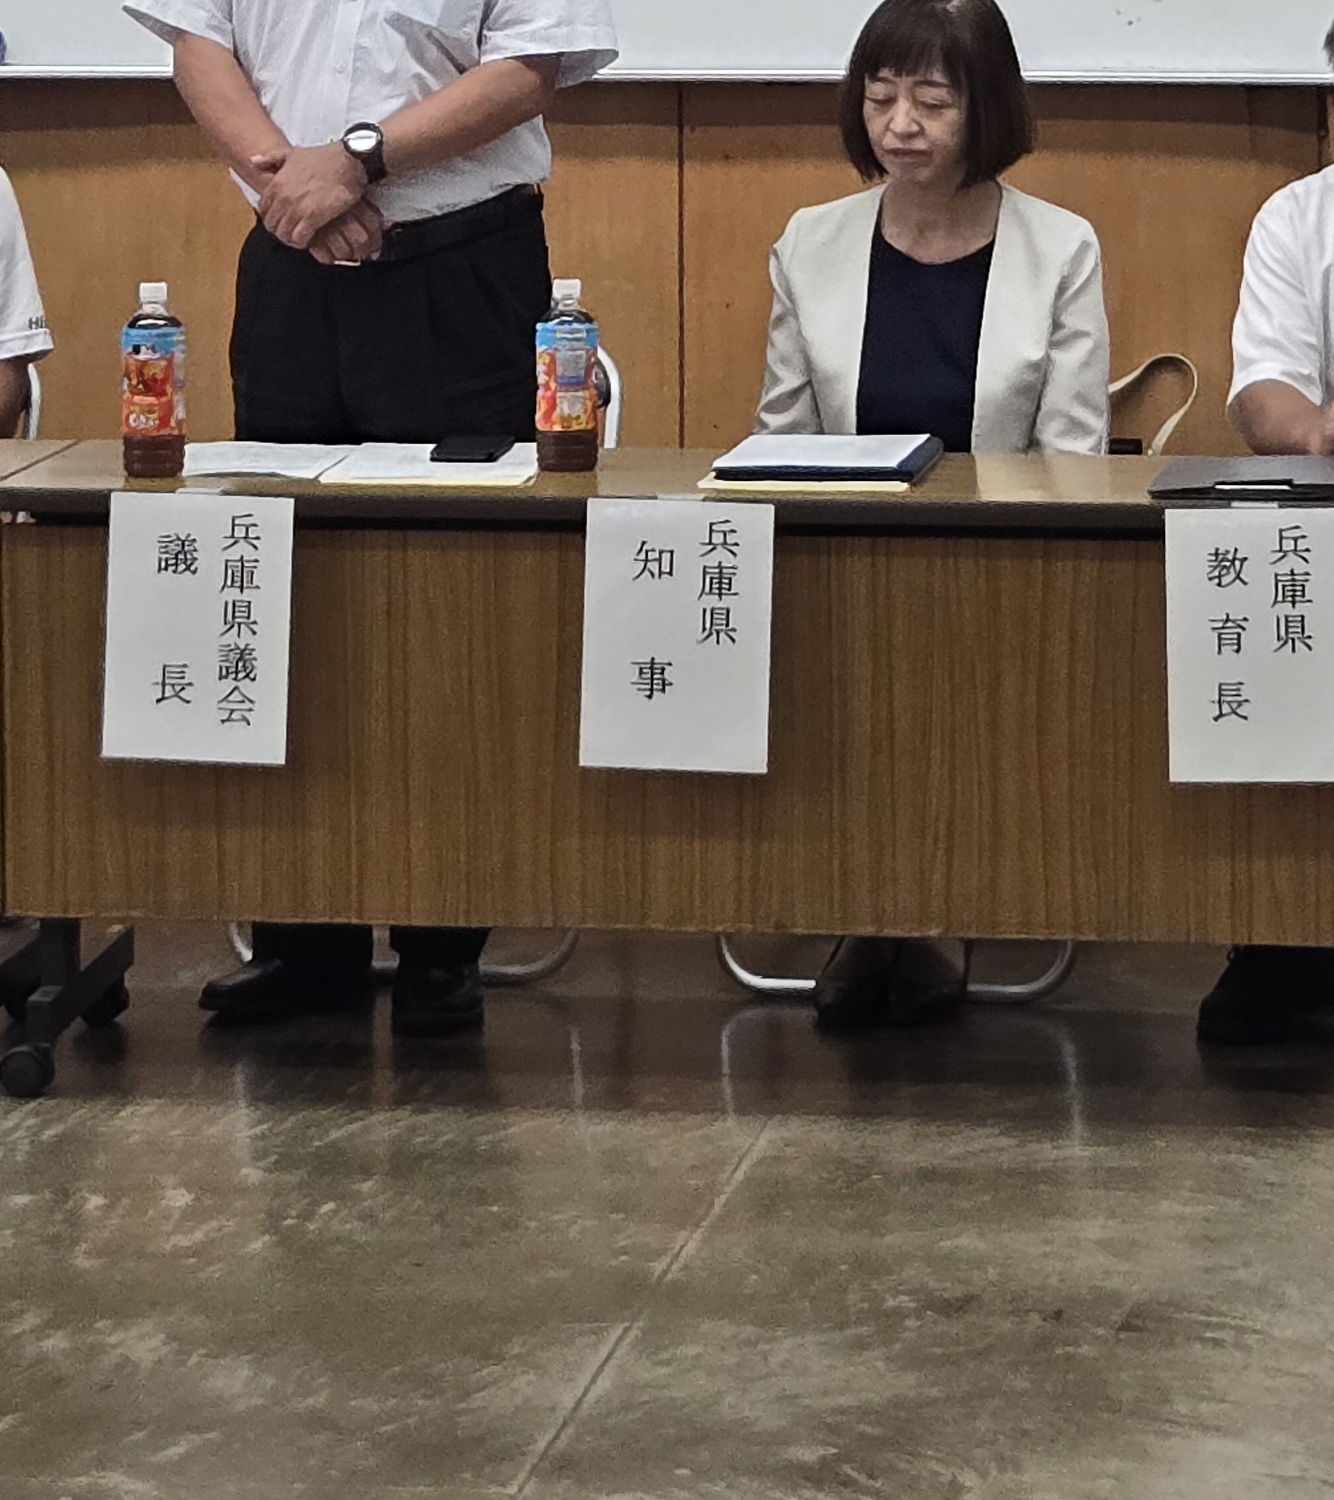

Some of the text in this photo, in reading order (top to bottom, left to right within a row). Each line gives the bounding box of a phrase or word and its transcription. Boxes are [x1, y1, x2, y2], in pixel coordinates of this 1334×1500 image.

[153, 532, 200, 705] 議長
[217, 512, 262, 727] 兵庫県議会
[631, 538, 675, 702] 知事
[696, 518, 740, 647] 兵庫県
[1207, 546, 1251, 722] 教育長
[1270, 525, 1314, 655] 兵庫県
